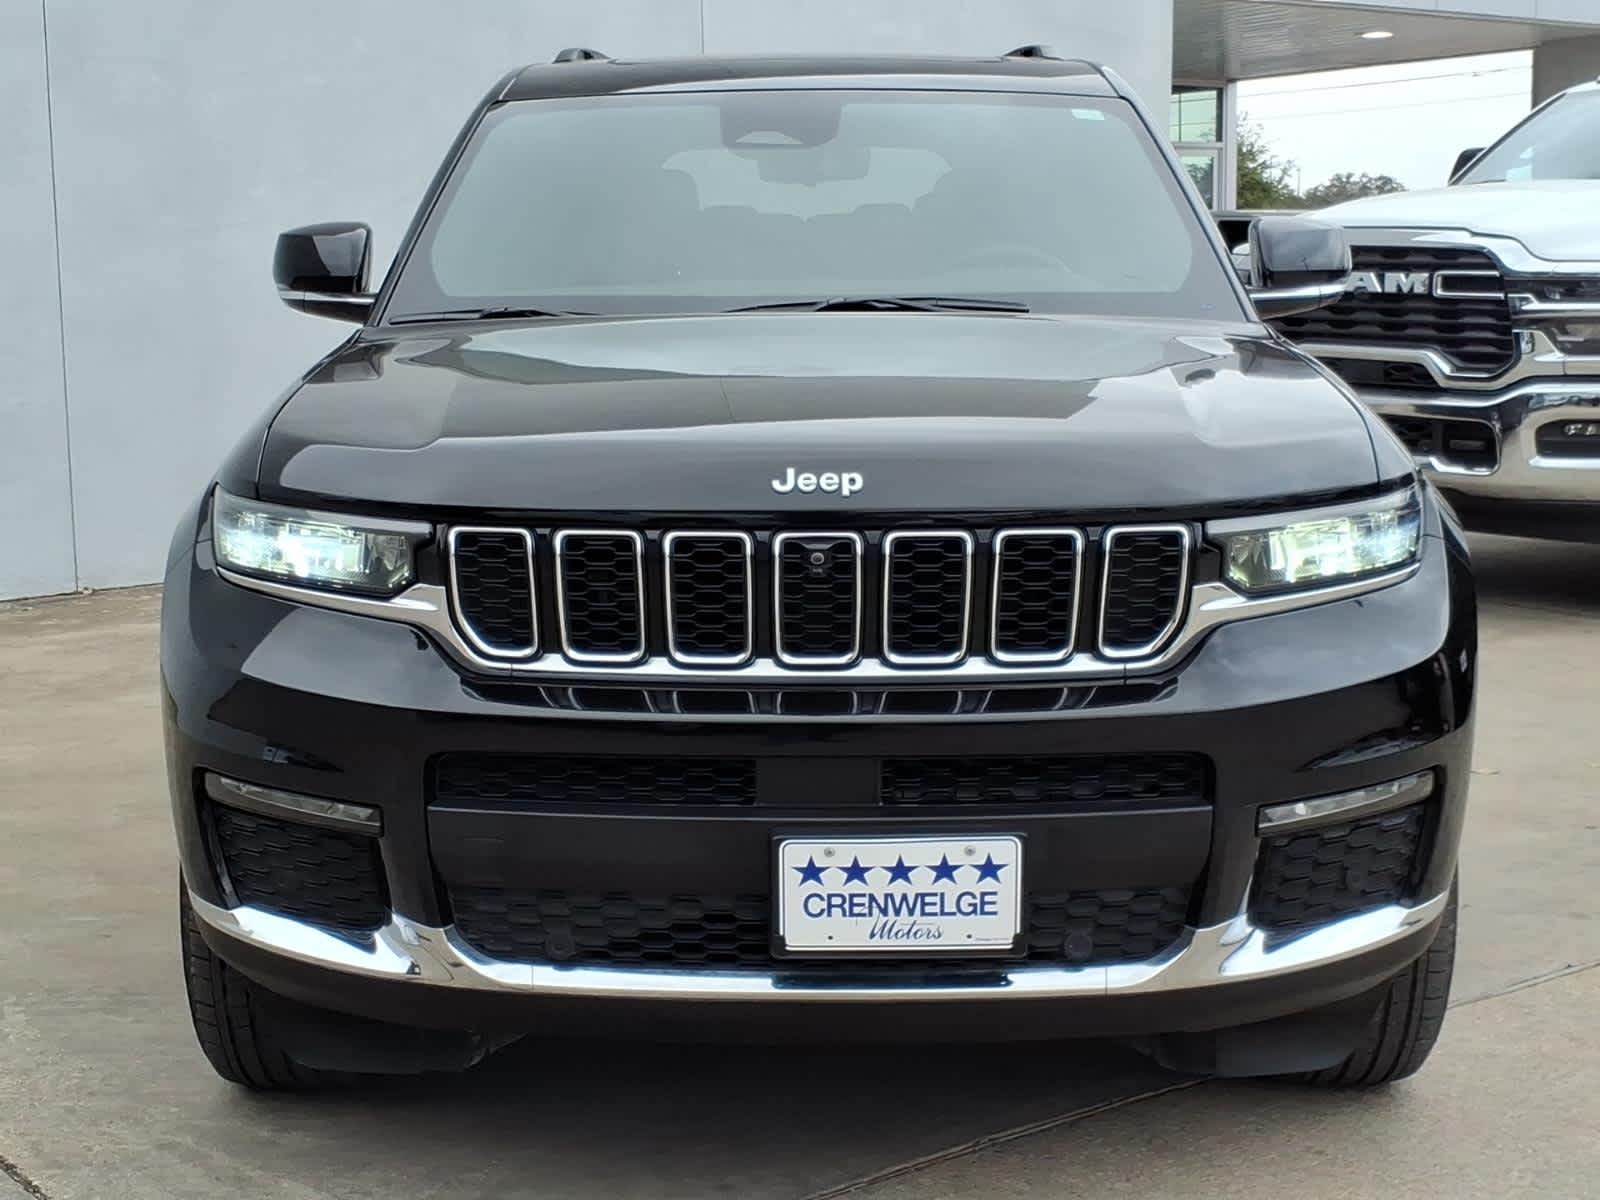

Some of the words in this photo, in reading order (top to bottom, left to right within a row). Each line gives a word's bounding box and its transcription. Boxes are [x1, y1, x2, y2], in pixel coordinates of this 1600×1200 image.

[1345, 271, 1430, 294] AM
[771, 467, 864, 497] Jeep
[803, 891, 998, 918] CRENWELGE
[869, 914, 944, 940] Motors
